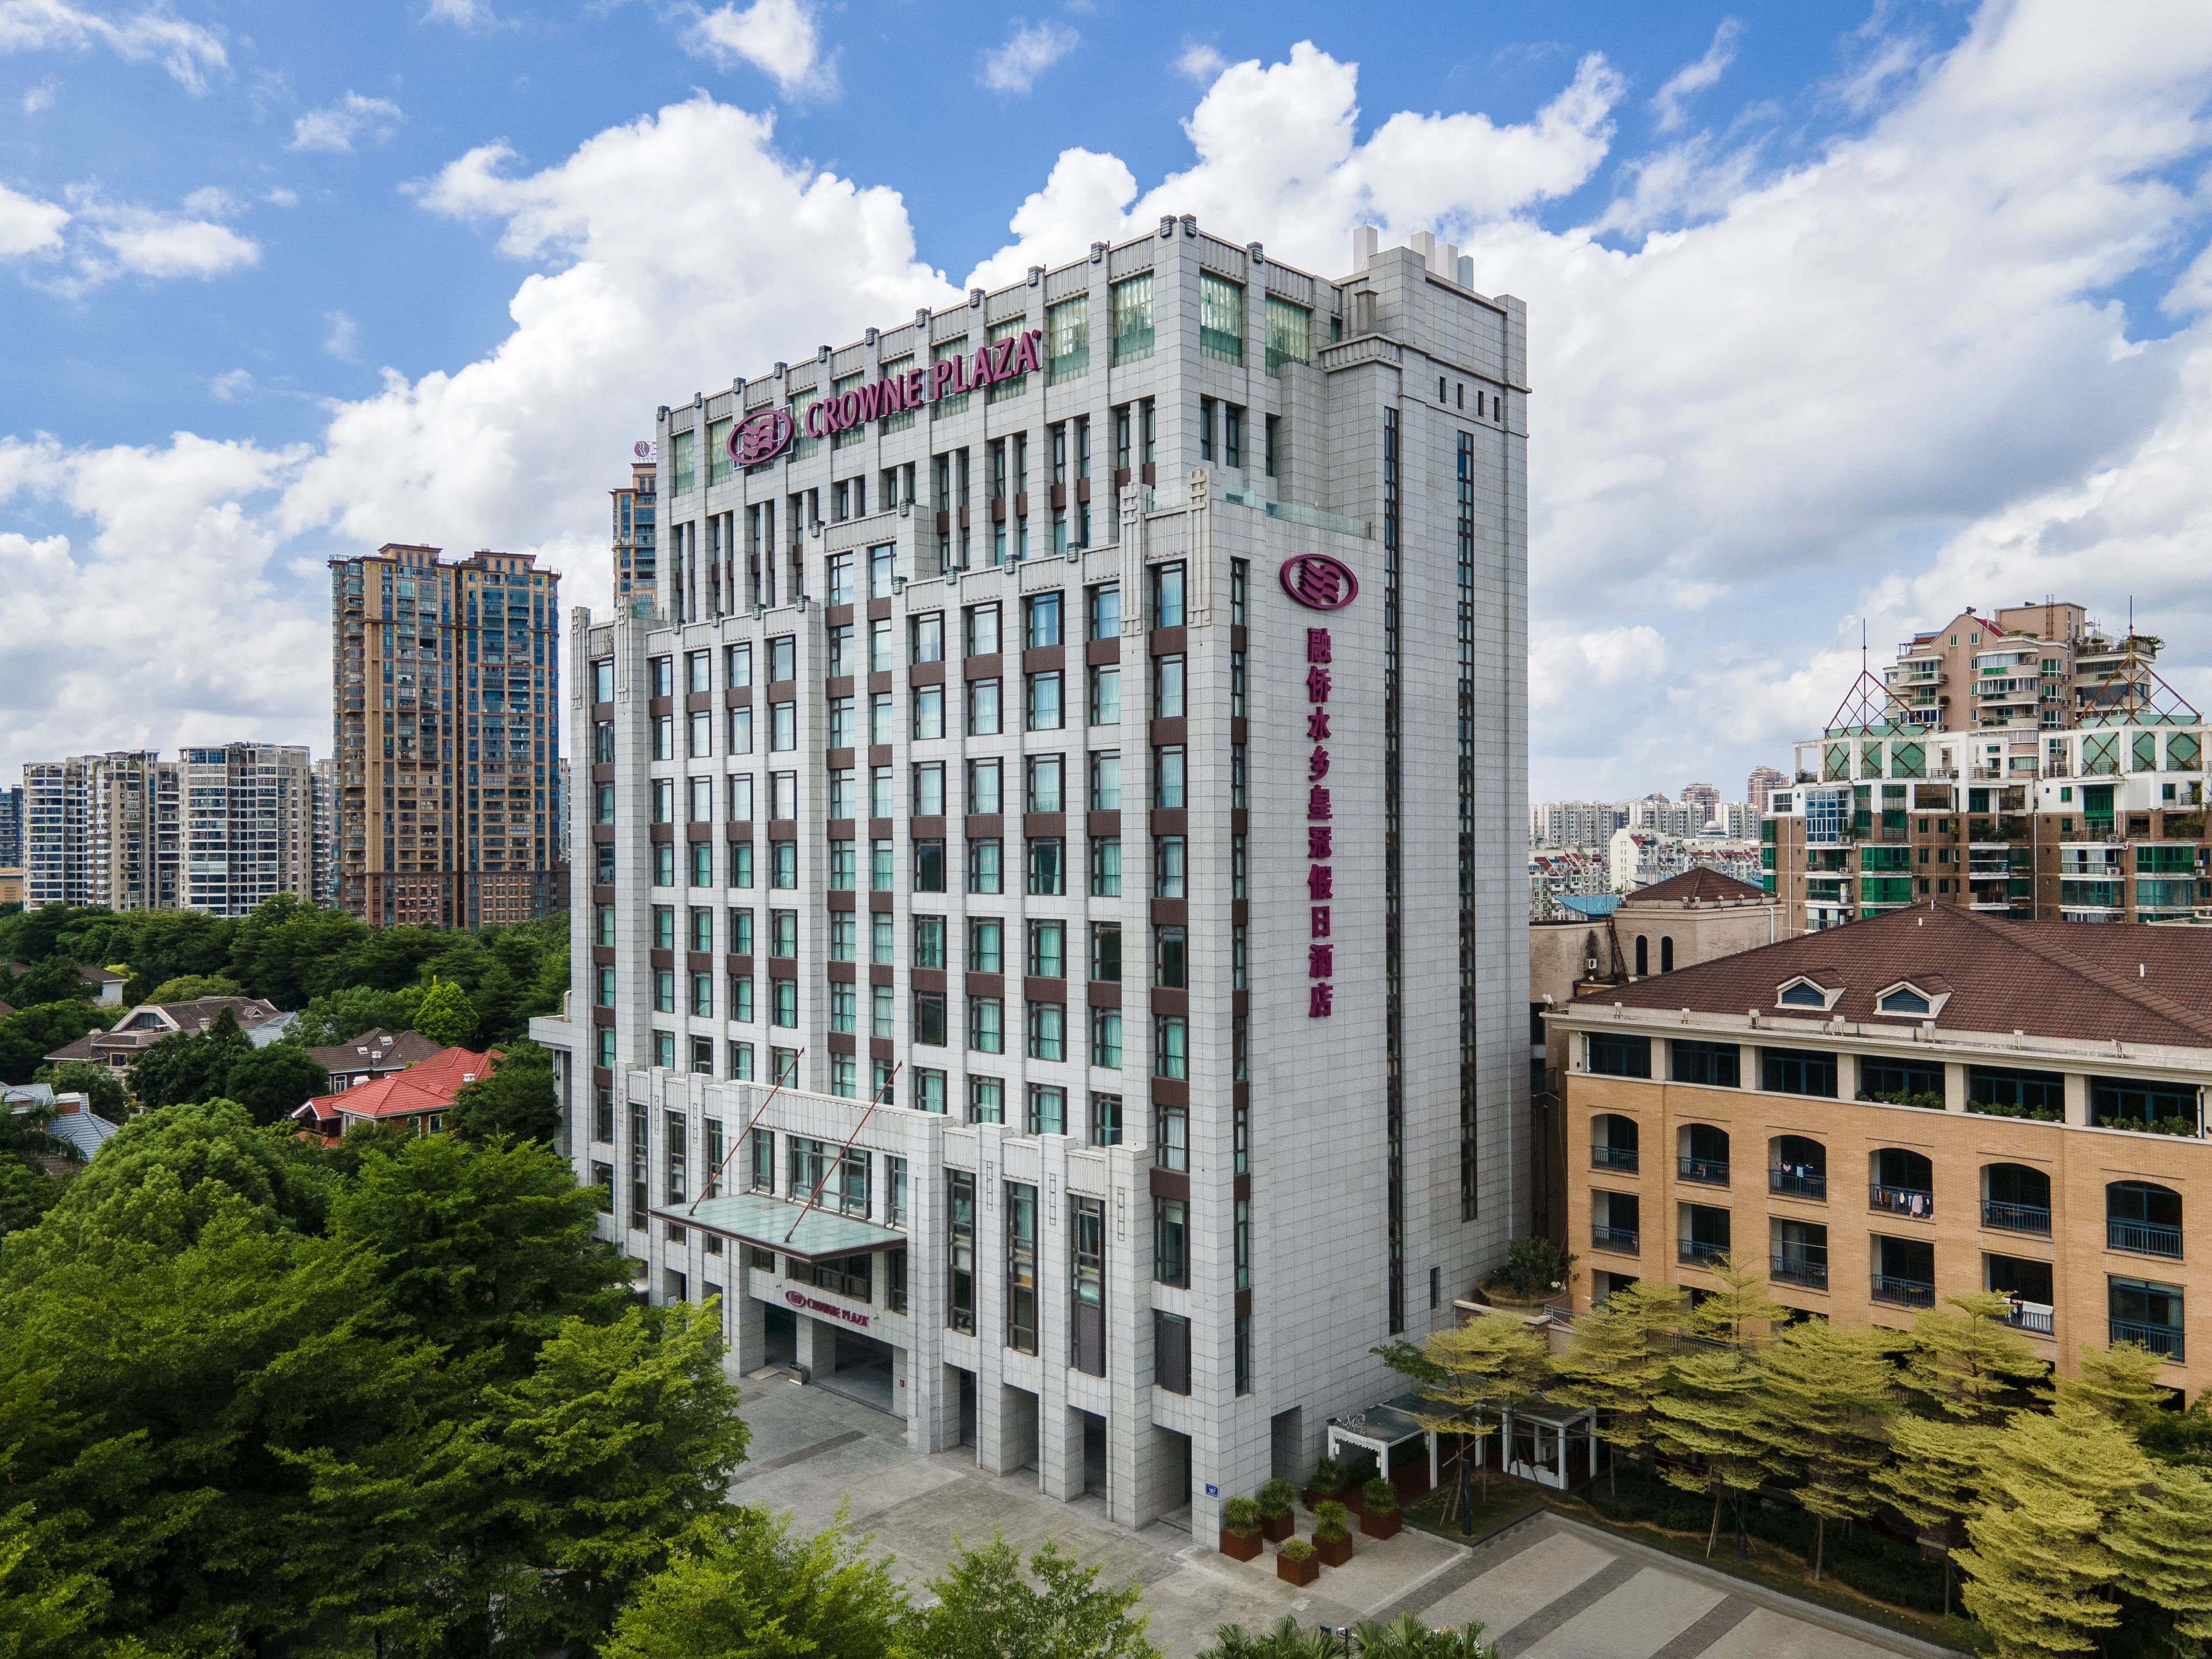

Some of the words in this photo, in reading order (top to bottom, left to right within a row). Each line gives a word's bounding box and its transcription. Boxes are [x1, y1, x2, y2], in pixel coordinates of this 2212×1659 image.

[805, 368, 925, 438] CROWNE
[933, 331, 1039, 400] PLAZA
[1306, 627, 1334, 1018] 融侨水乡皇冠假日酒店
